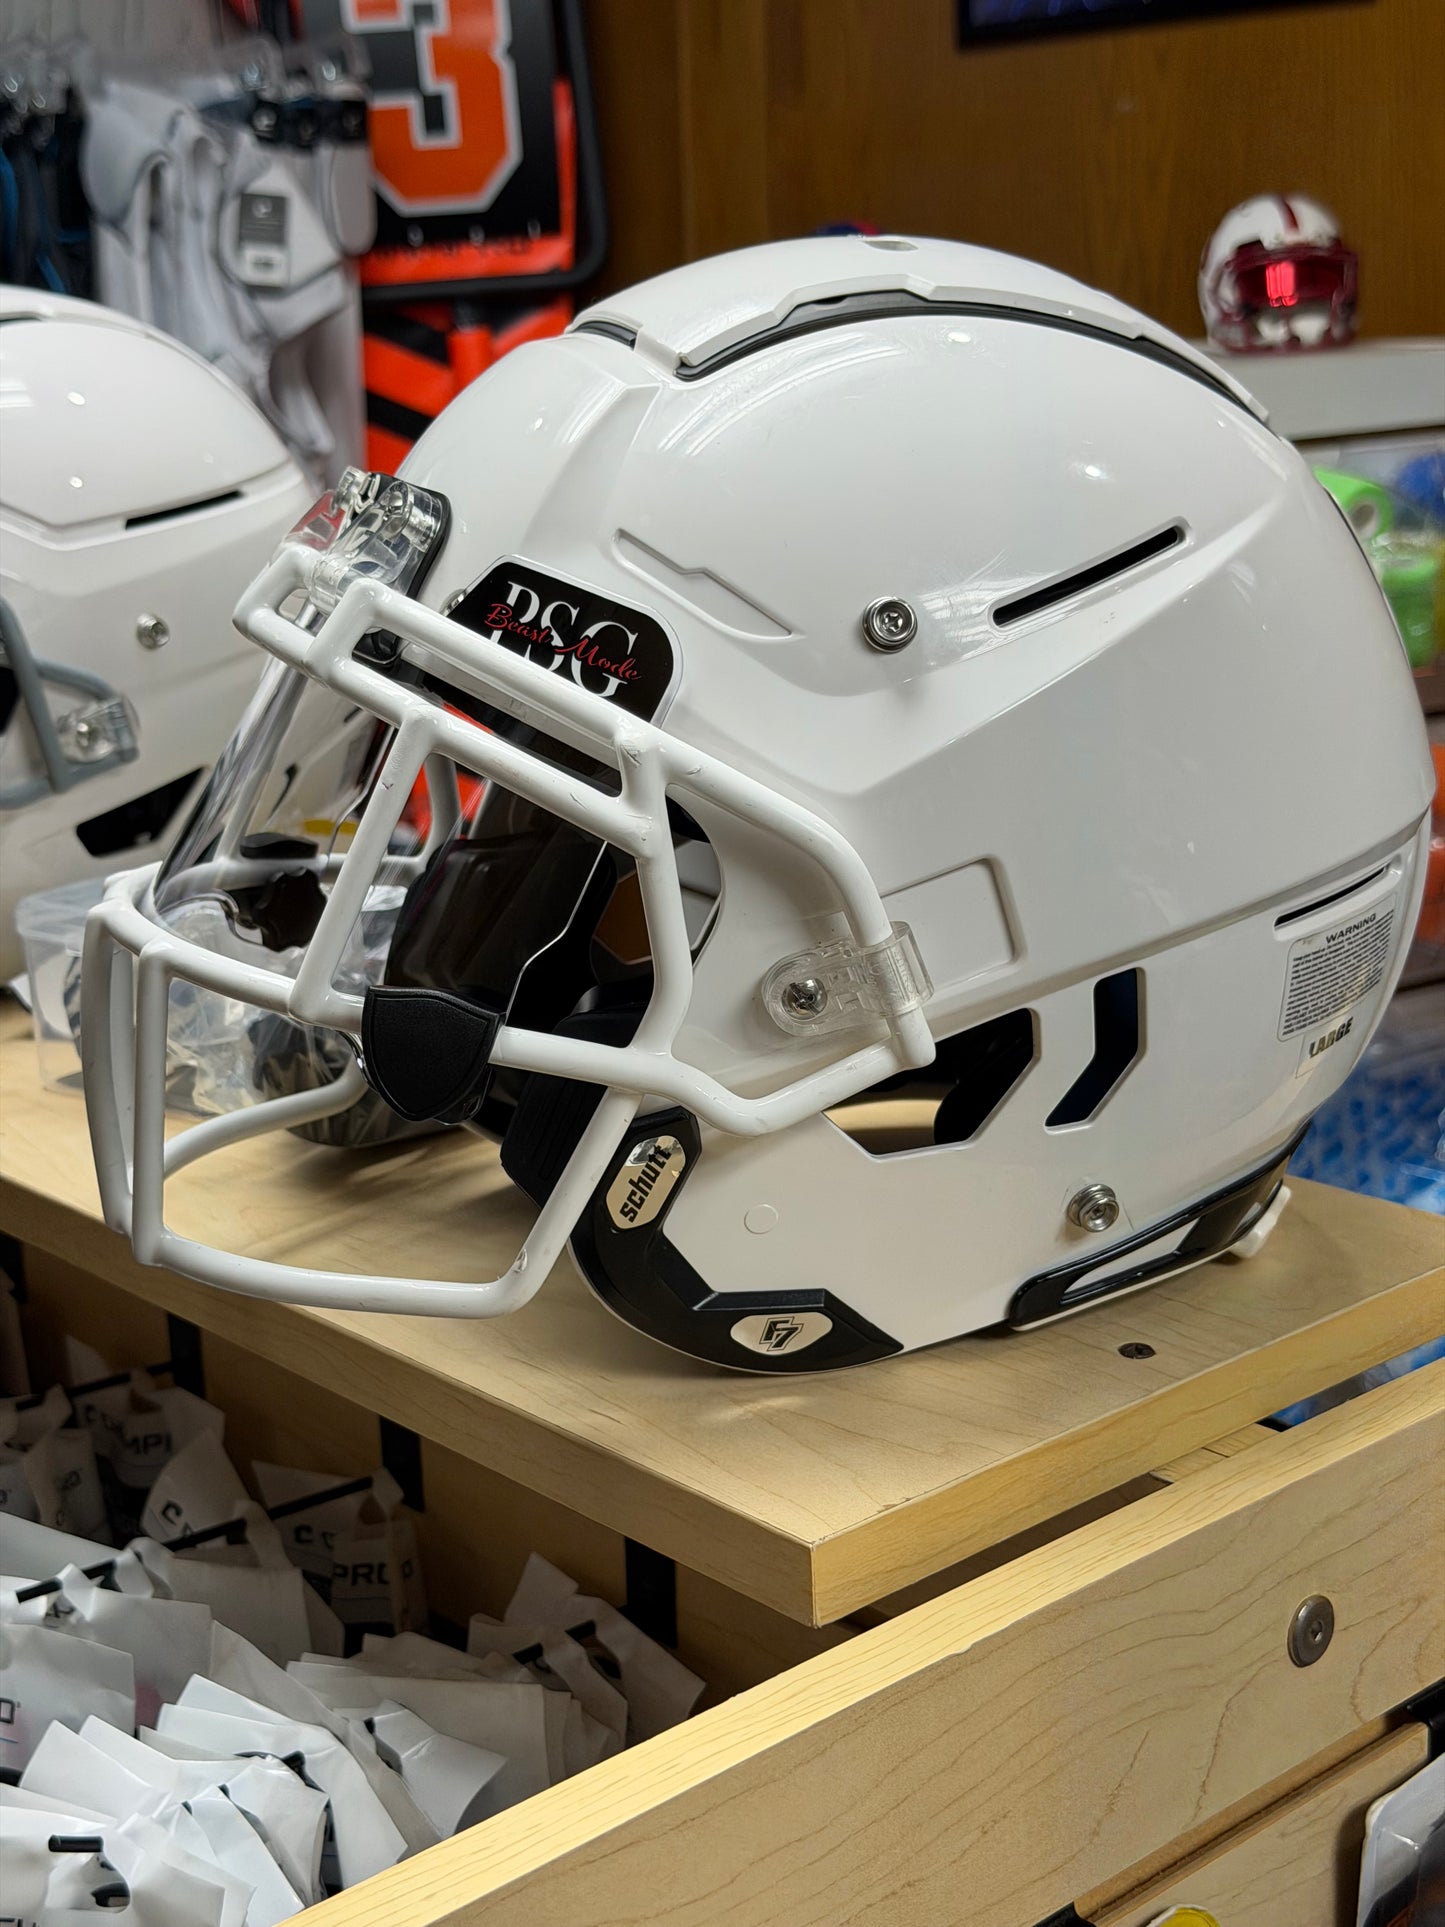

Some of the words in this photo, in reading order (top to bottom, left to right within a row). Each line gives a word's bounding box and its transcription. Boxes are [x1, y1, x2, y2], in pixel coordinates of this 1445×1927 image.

[484, 603, 552, 643] Beast
[554, 637, 641, 681] Mode
[1325, 912, 1377, 944] WARNING
[1309, 1016, 1354, 1058] LARGE
[619, 1144, 672, 1223] schutt
